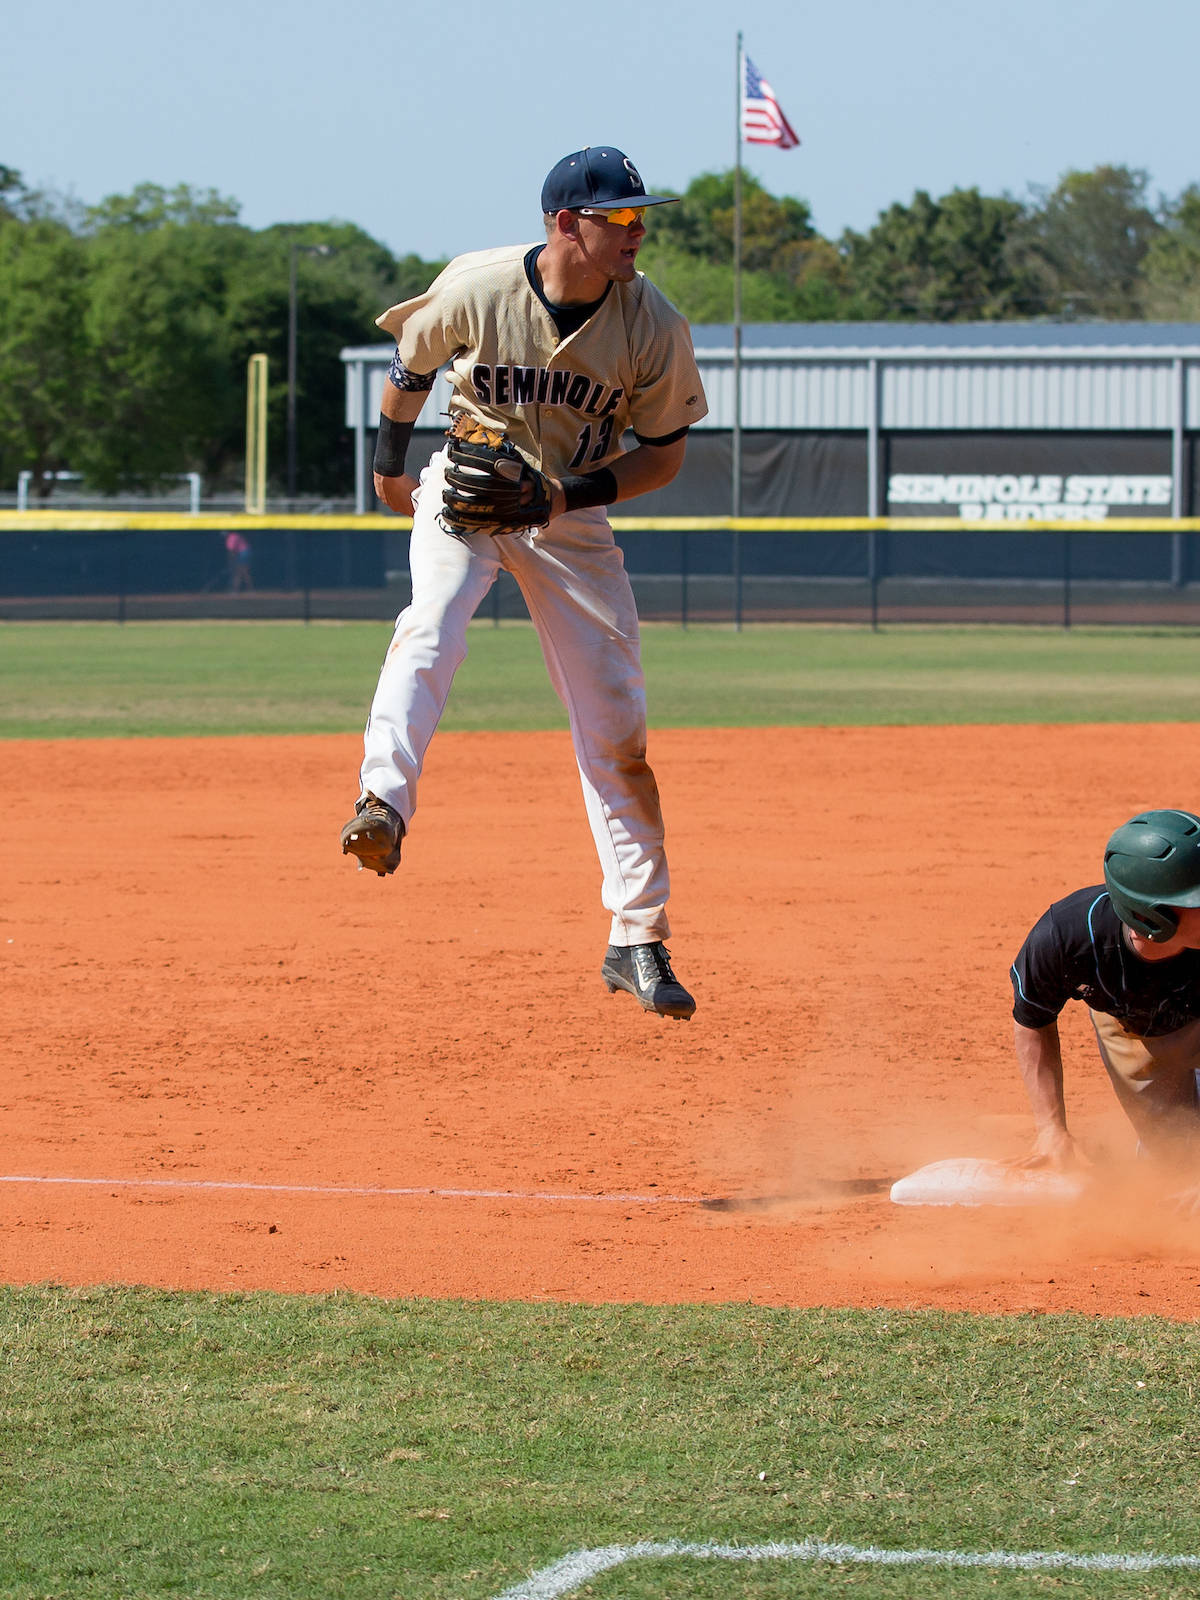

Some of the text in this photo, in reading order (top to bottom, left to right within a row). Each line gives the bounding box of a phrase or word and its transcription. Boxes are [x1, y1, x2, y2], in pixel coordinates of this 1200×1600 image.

[471, 363, 625, 417] SEMINOLE
[567, 414, 615, 469] 13
[888, 474, 1173, 504] SEMINOLE STATE
